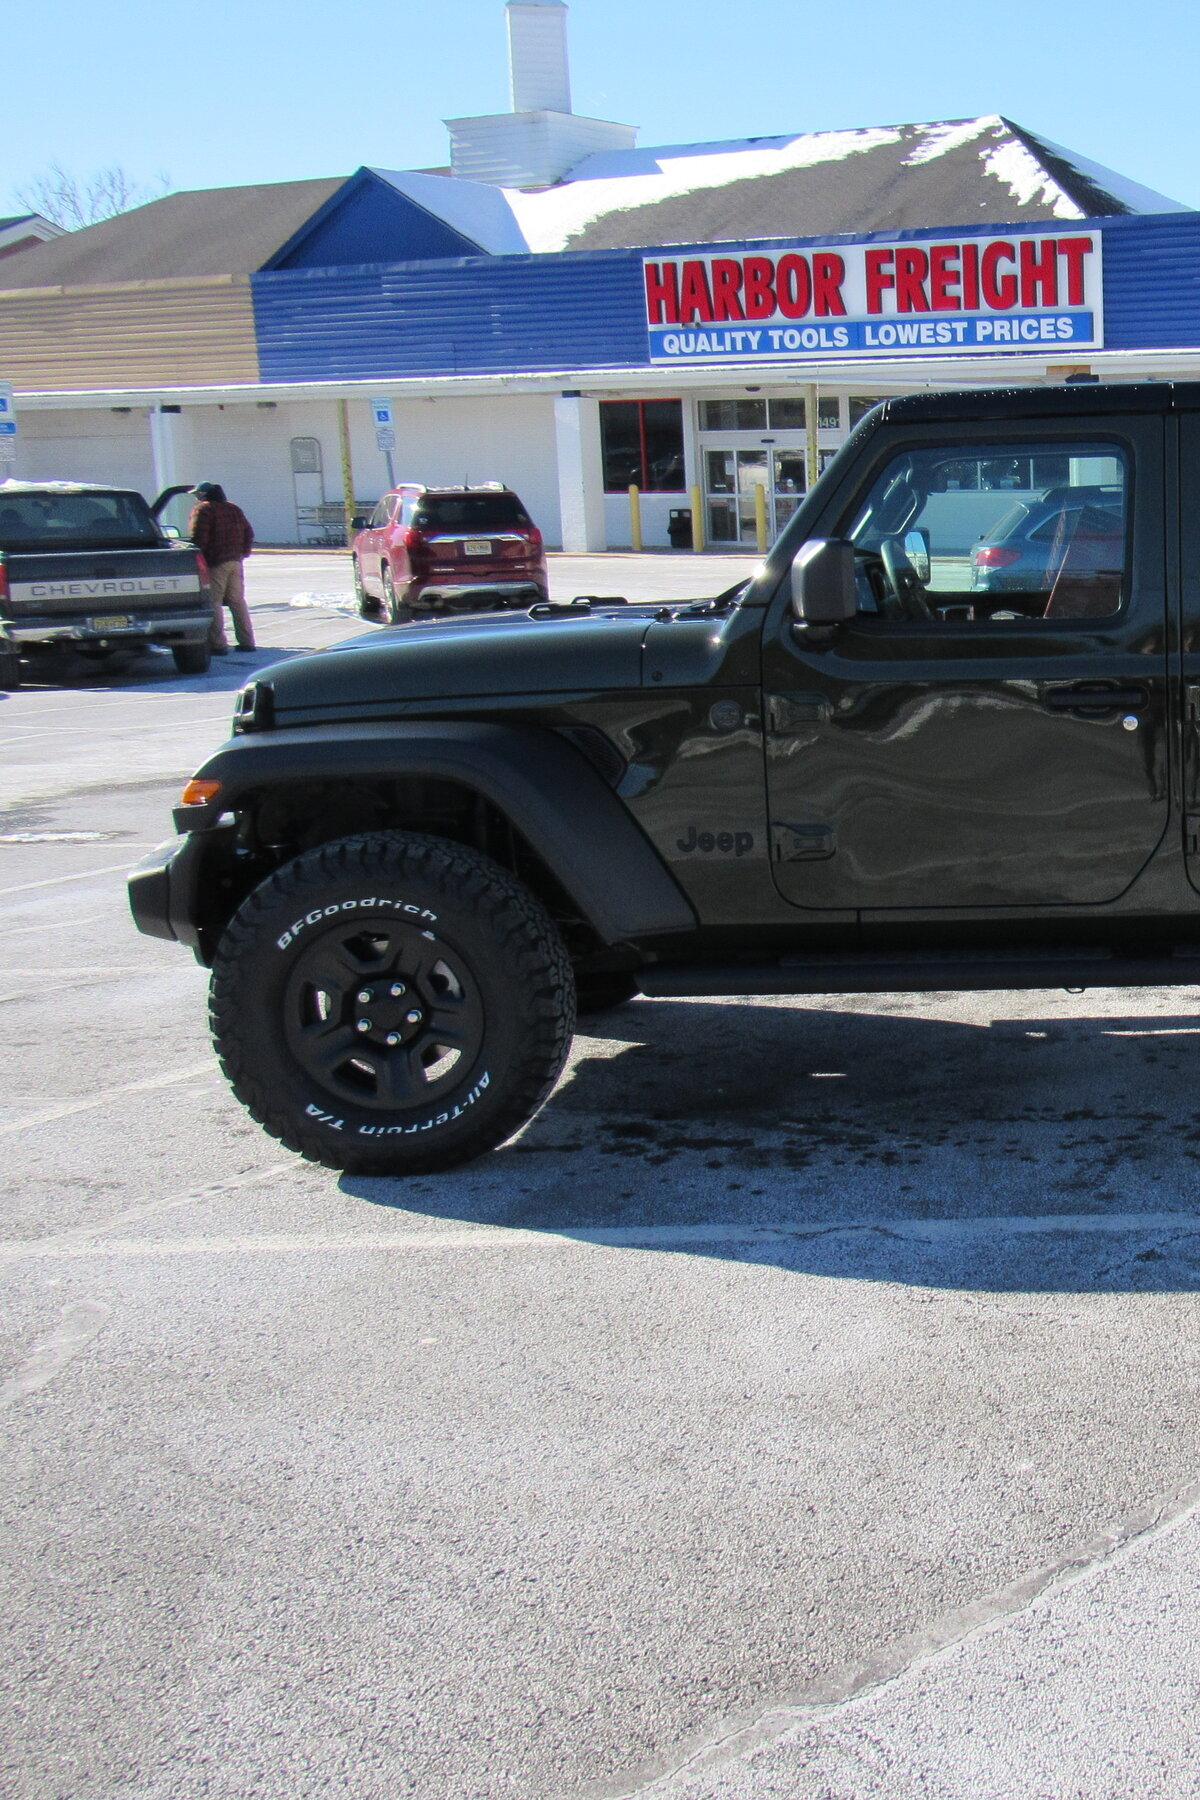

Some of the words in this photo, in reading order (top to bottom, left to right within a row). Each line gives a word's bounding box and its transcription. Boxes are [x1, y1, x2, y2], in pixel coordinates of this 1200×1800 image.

[645, 252, 847, 325] HARBOR
[865, 237, 1094, 315] FREIGHT
[662, 330, 763, 355] QUALITY
[768, 326, 849, 350] TOOLS
[865, 321, 972, 346] LOWEST
[976, 317, 1074, 342] PRICES
[31, 579, 181, 597] CHEVROLET
[676, 826, 754, 857] Jeep
[276, 897, 438, 950] BFGoodrich
[305, 1103, 345, 1131] T/A
[358, 1071, 491, 1138] All-Terrain
